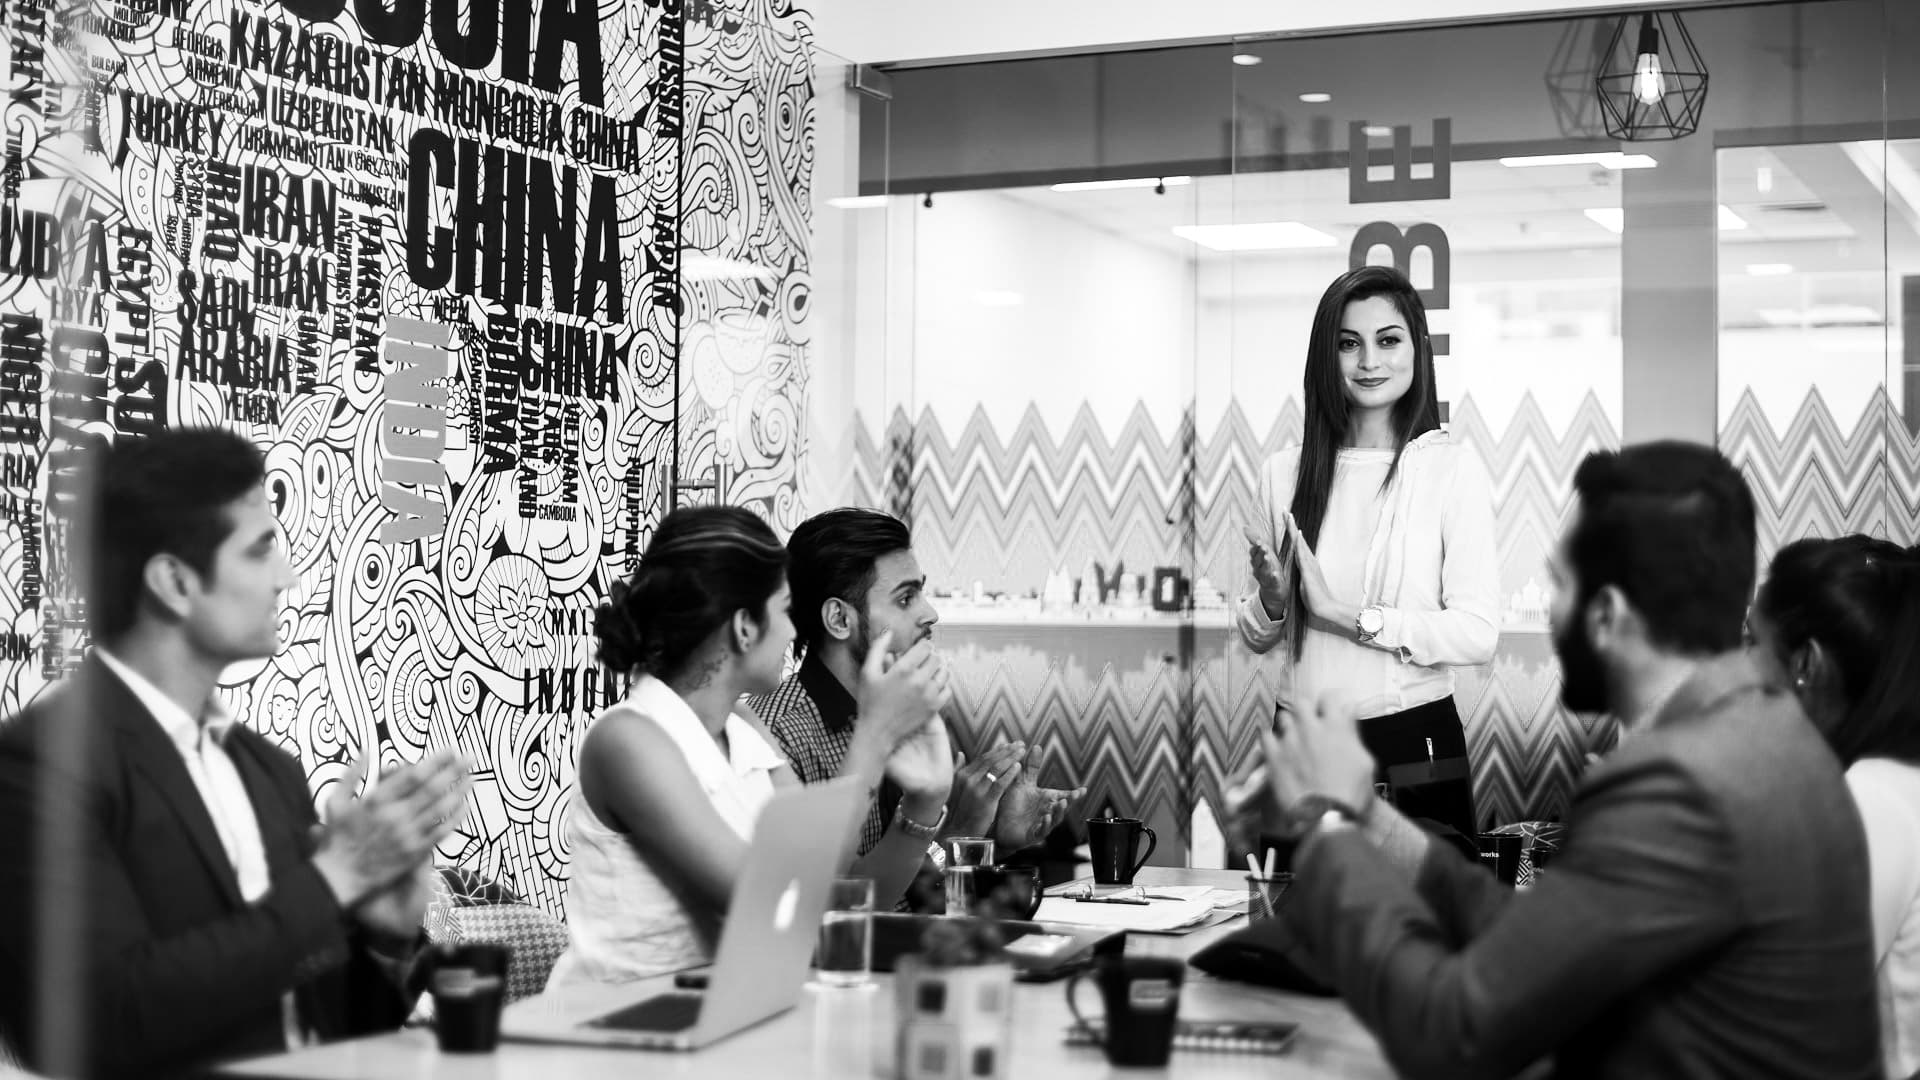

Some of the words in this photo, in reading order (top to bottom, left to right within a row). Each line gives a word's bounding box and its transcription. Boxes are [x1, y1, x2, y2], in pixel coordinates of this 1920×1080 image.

[119, 86, 226, 160] TURKEY
[229, 7, 426, 117] KAZAKHSTAN
[433, 66, 563, 154] MONGOLIA
[570, 107, 641, 175] CHINA
[271, 85, 394, 152] UZBEKISTAN
[658, 15, 681, 138] RUSSIA
[237, 123, 346, 173] TURKMENISTAN
[204, 160, 242, 262] IRAQ
[242, 163, 337, 252] IRAN
[407, 127, 625, 325] CHINA
[652, 204, 679, 308] JAPAN
[115, 223, 152, 353] EGYPT
[252, 245, 328, 315] IRAN
[353, 214, 383, 374] PAKISTAN
[0, 313, 43, 445] NIGER
[295, 315, 319, 395] OMAN
[518, 317, 620, 403] CHINA
[380, 314, 450, 546] INDIA
[538, 504, 578, 523] CAMBODIA
